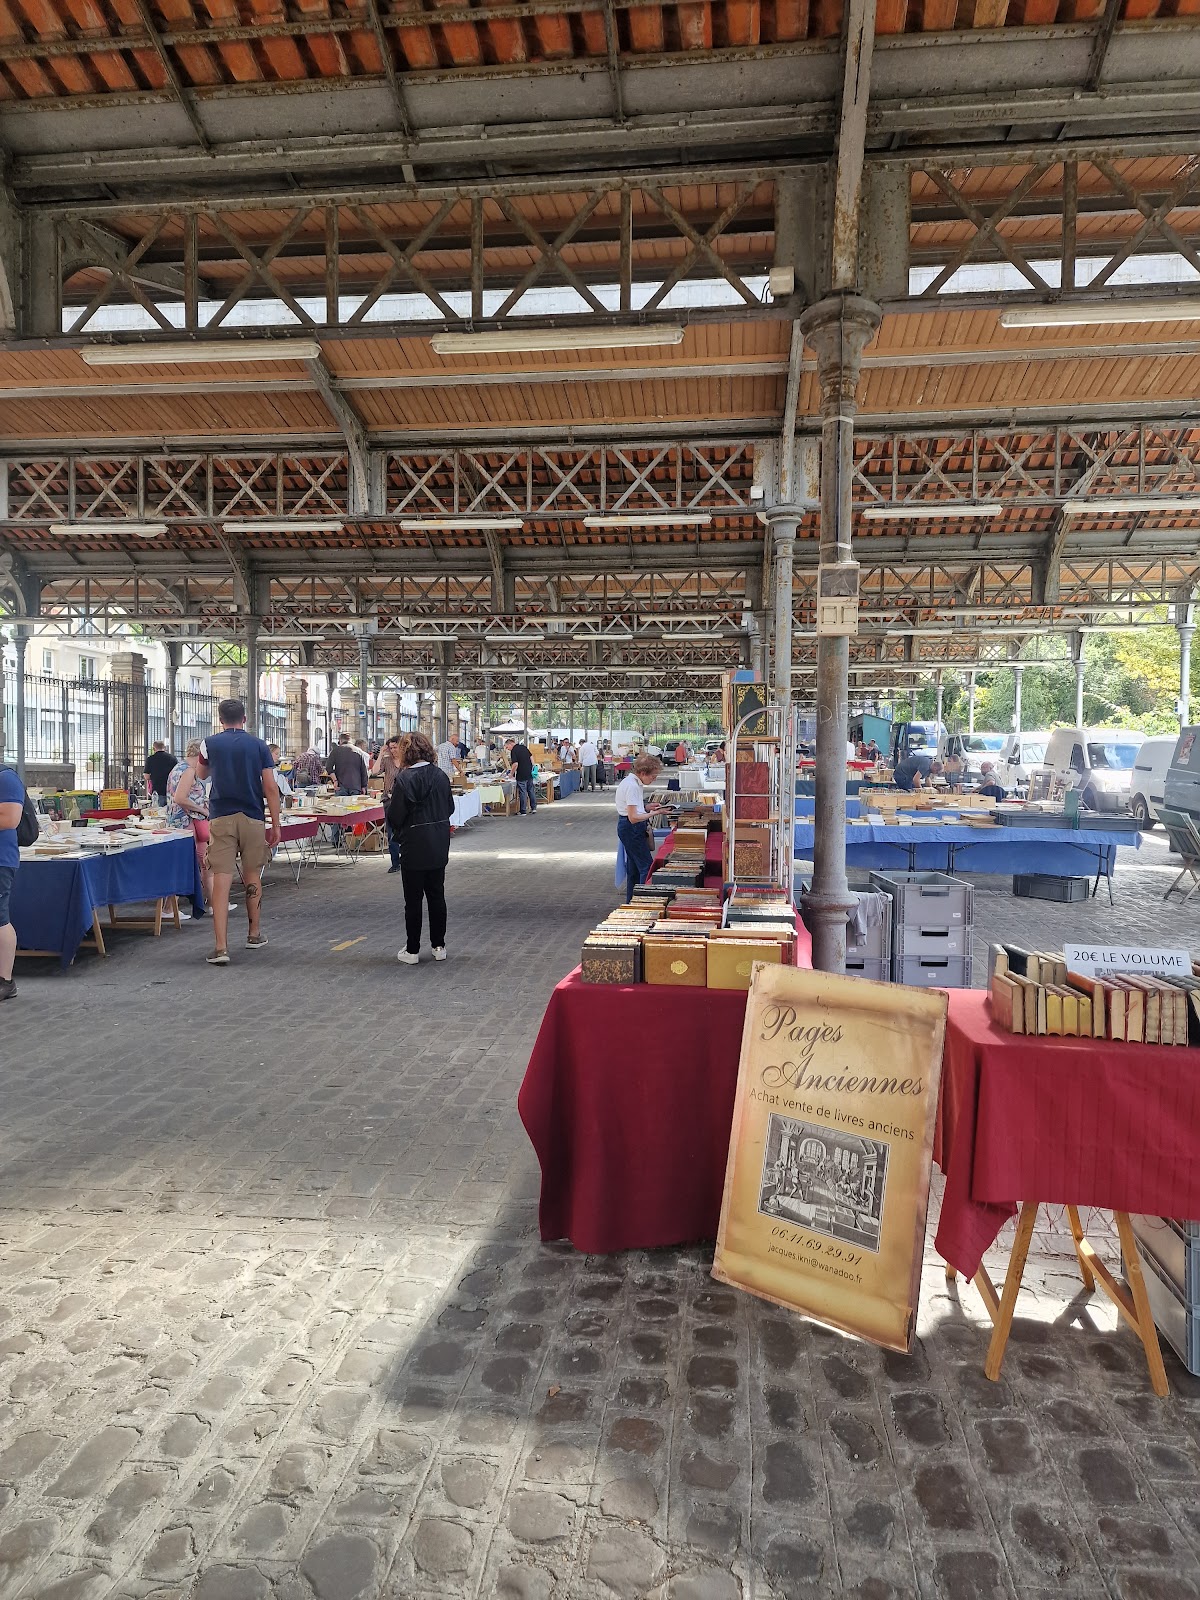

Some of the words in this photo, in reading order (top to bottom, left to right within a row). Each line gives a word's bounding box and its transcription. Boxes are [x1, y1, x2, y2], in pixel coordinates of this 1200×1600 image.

[1073, 950, 1099, 962] 20€
[1102, 952, 1117, 963] LE
[1120, 953, 1184, 967] VOLUME
[761, 1004, 844, 1057] Pages
[761, 1053, 925, 1096] Anciennes
[749, 1087, 780, 1106] Achat
[783, 1099, 813, 1114] vente
[816, 1105, 831, 1118] de
[834, 1108, 864, 1127] livres
[868, 1119, 915, 1141] anciens
[767, 1242, 863, 1284] jacques.ikni@wanadoo.fr
[771, 1226, 863, 1266] 06.11.69.29.91
